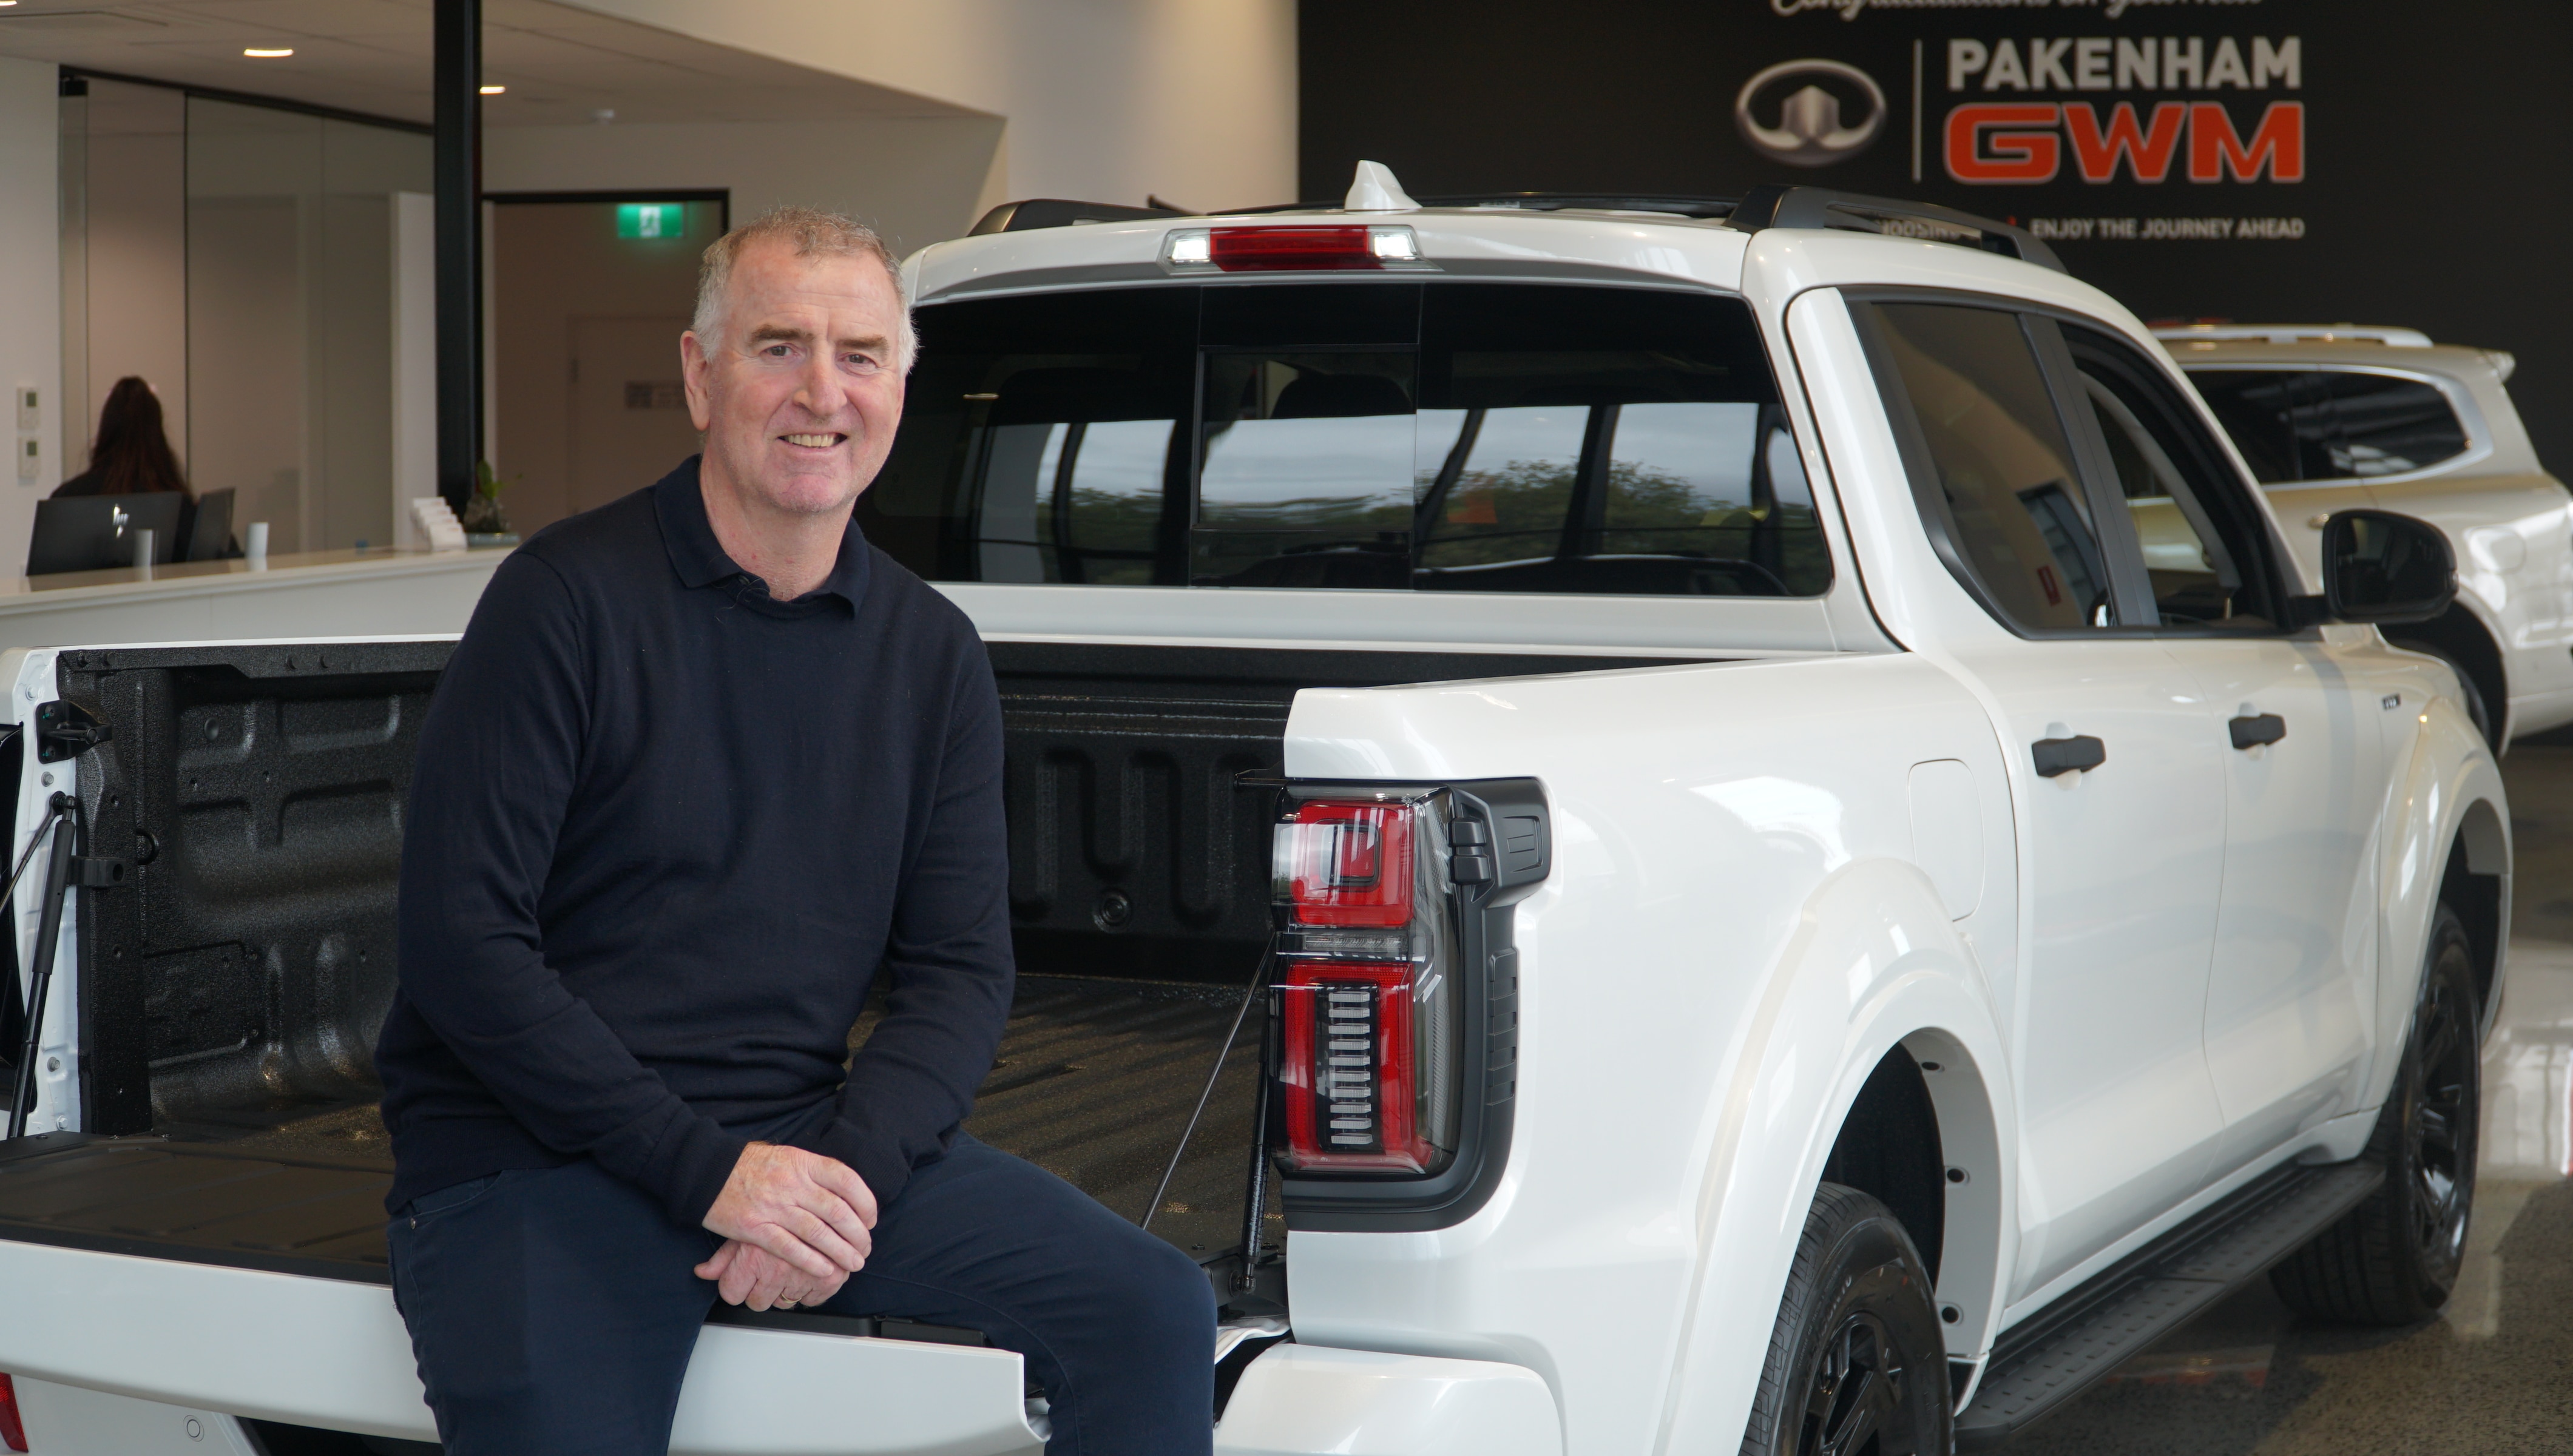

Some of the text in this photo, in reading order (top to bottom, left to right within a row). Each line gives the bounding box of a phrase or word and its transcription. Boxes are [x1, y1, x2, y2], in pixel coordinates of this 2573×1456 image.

[1947, 37, 2302, 90] PAKENHAM
[1944, 101, 2305, 183] GWM
[2030, 217, 2305, 239] ENJOY THE JOURNEY AHEAD
